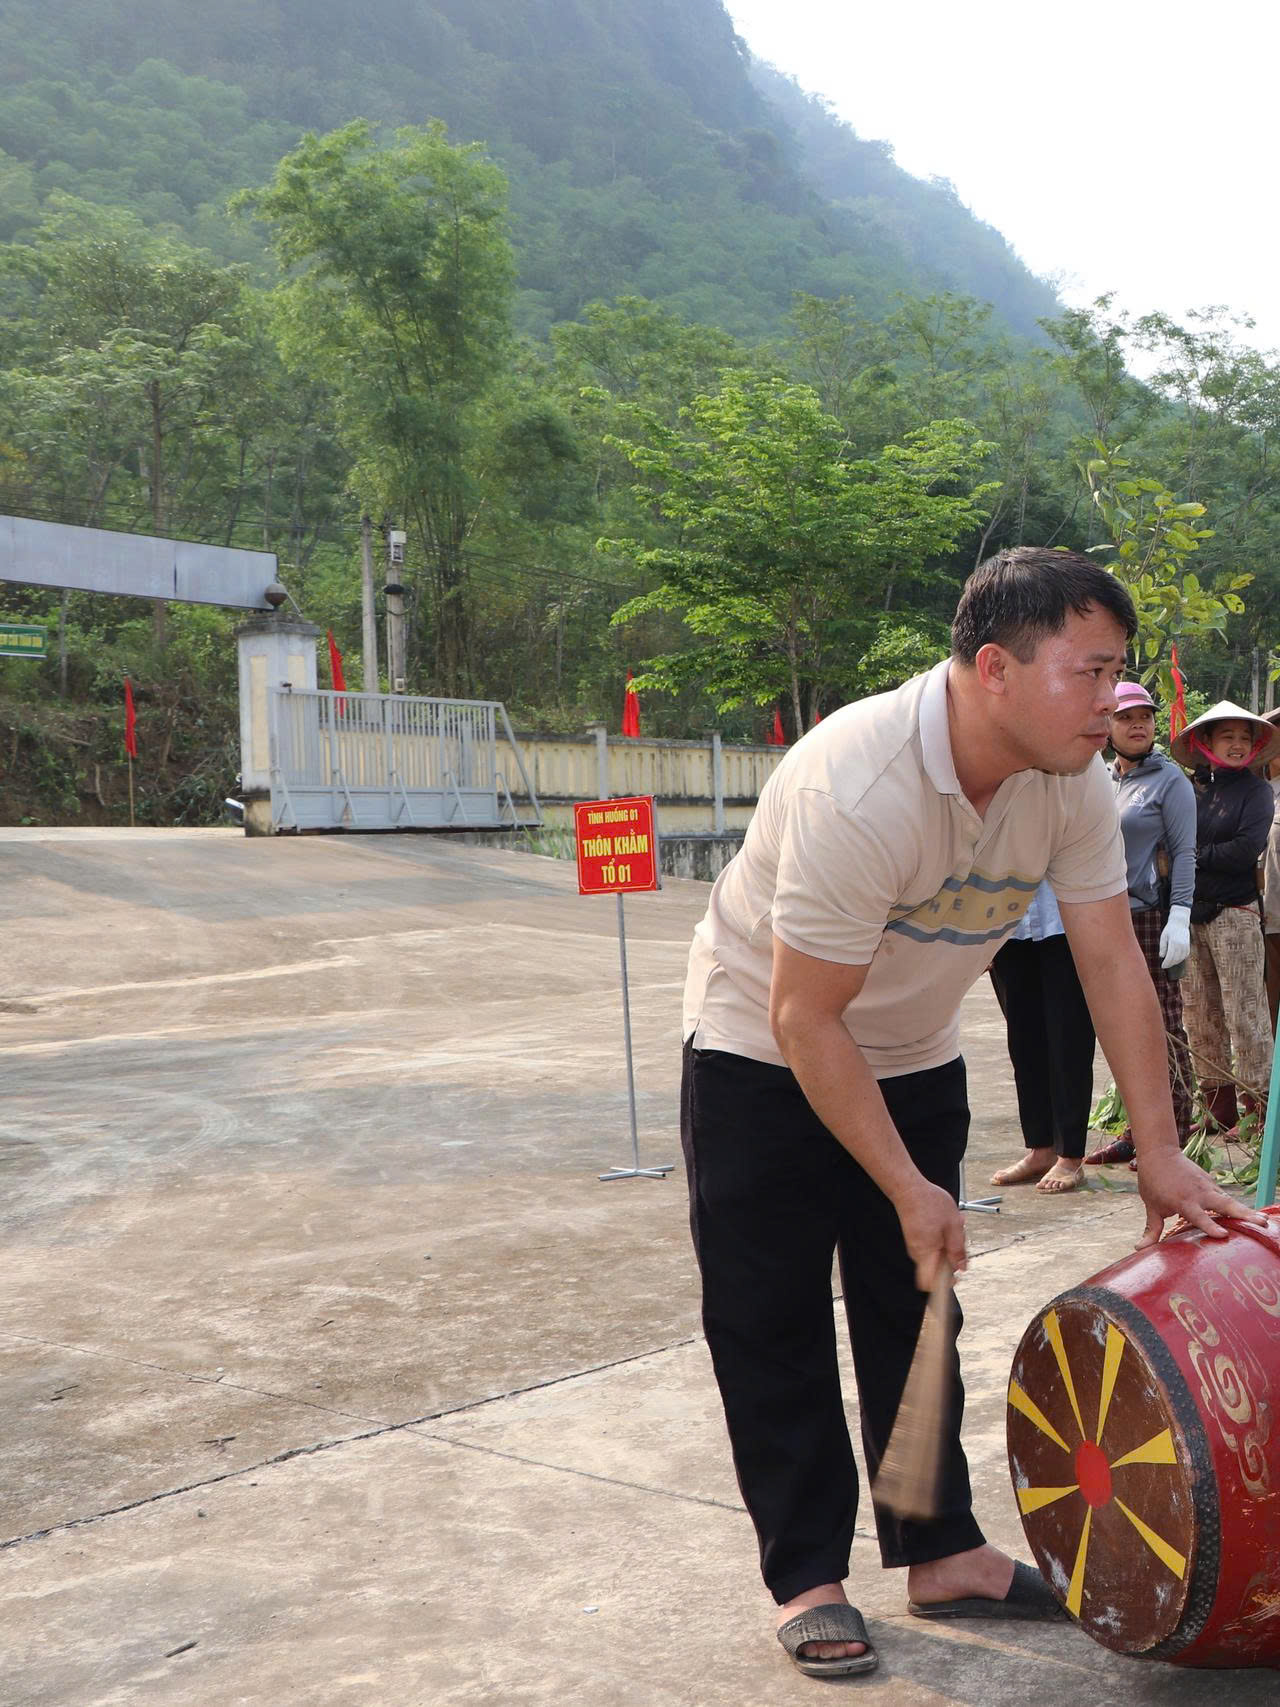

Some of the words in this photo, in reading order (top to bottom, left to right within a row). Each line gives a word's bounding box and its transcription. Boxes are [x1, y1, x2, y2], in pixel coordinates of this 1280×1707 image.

[588, 810, 604, 825] TÌNH
[605, 806, 628, 823] HUỐNG
[630, 809, 638, 821] 01
[583, 834, 612, 857] THÔN
[601, 857, 615, 884] TỔ
[618, 864, 631, 883] 01
